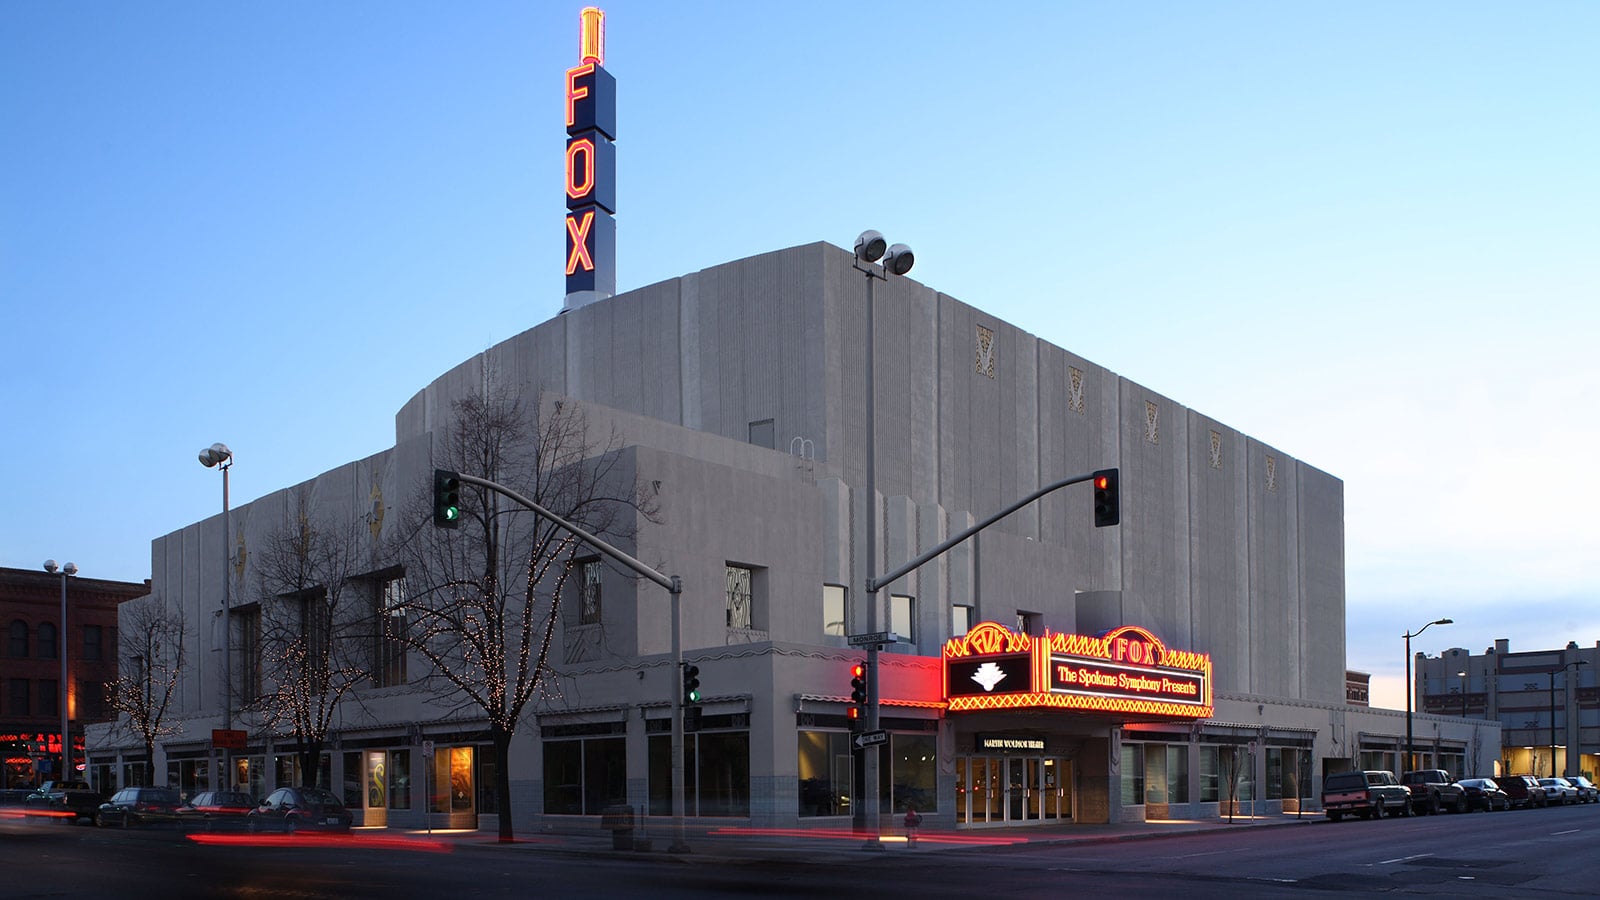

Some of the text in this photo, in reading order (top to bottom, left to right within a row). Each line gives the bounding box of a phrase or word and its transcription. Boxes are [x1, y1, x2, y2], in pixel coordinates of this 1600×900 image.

[565, 63, 595, 276] FOX
[853, 634, 882, 643] MONROE
[970, 627, 1003, 654] FOX
[1114, 637, 1155, 665] FOX
[1058, 666, 1197, 695] The Spokane Symphony Presents
